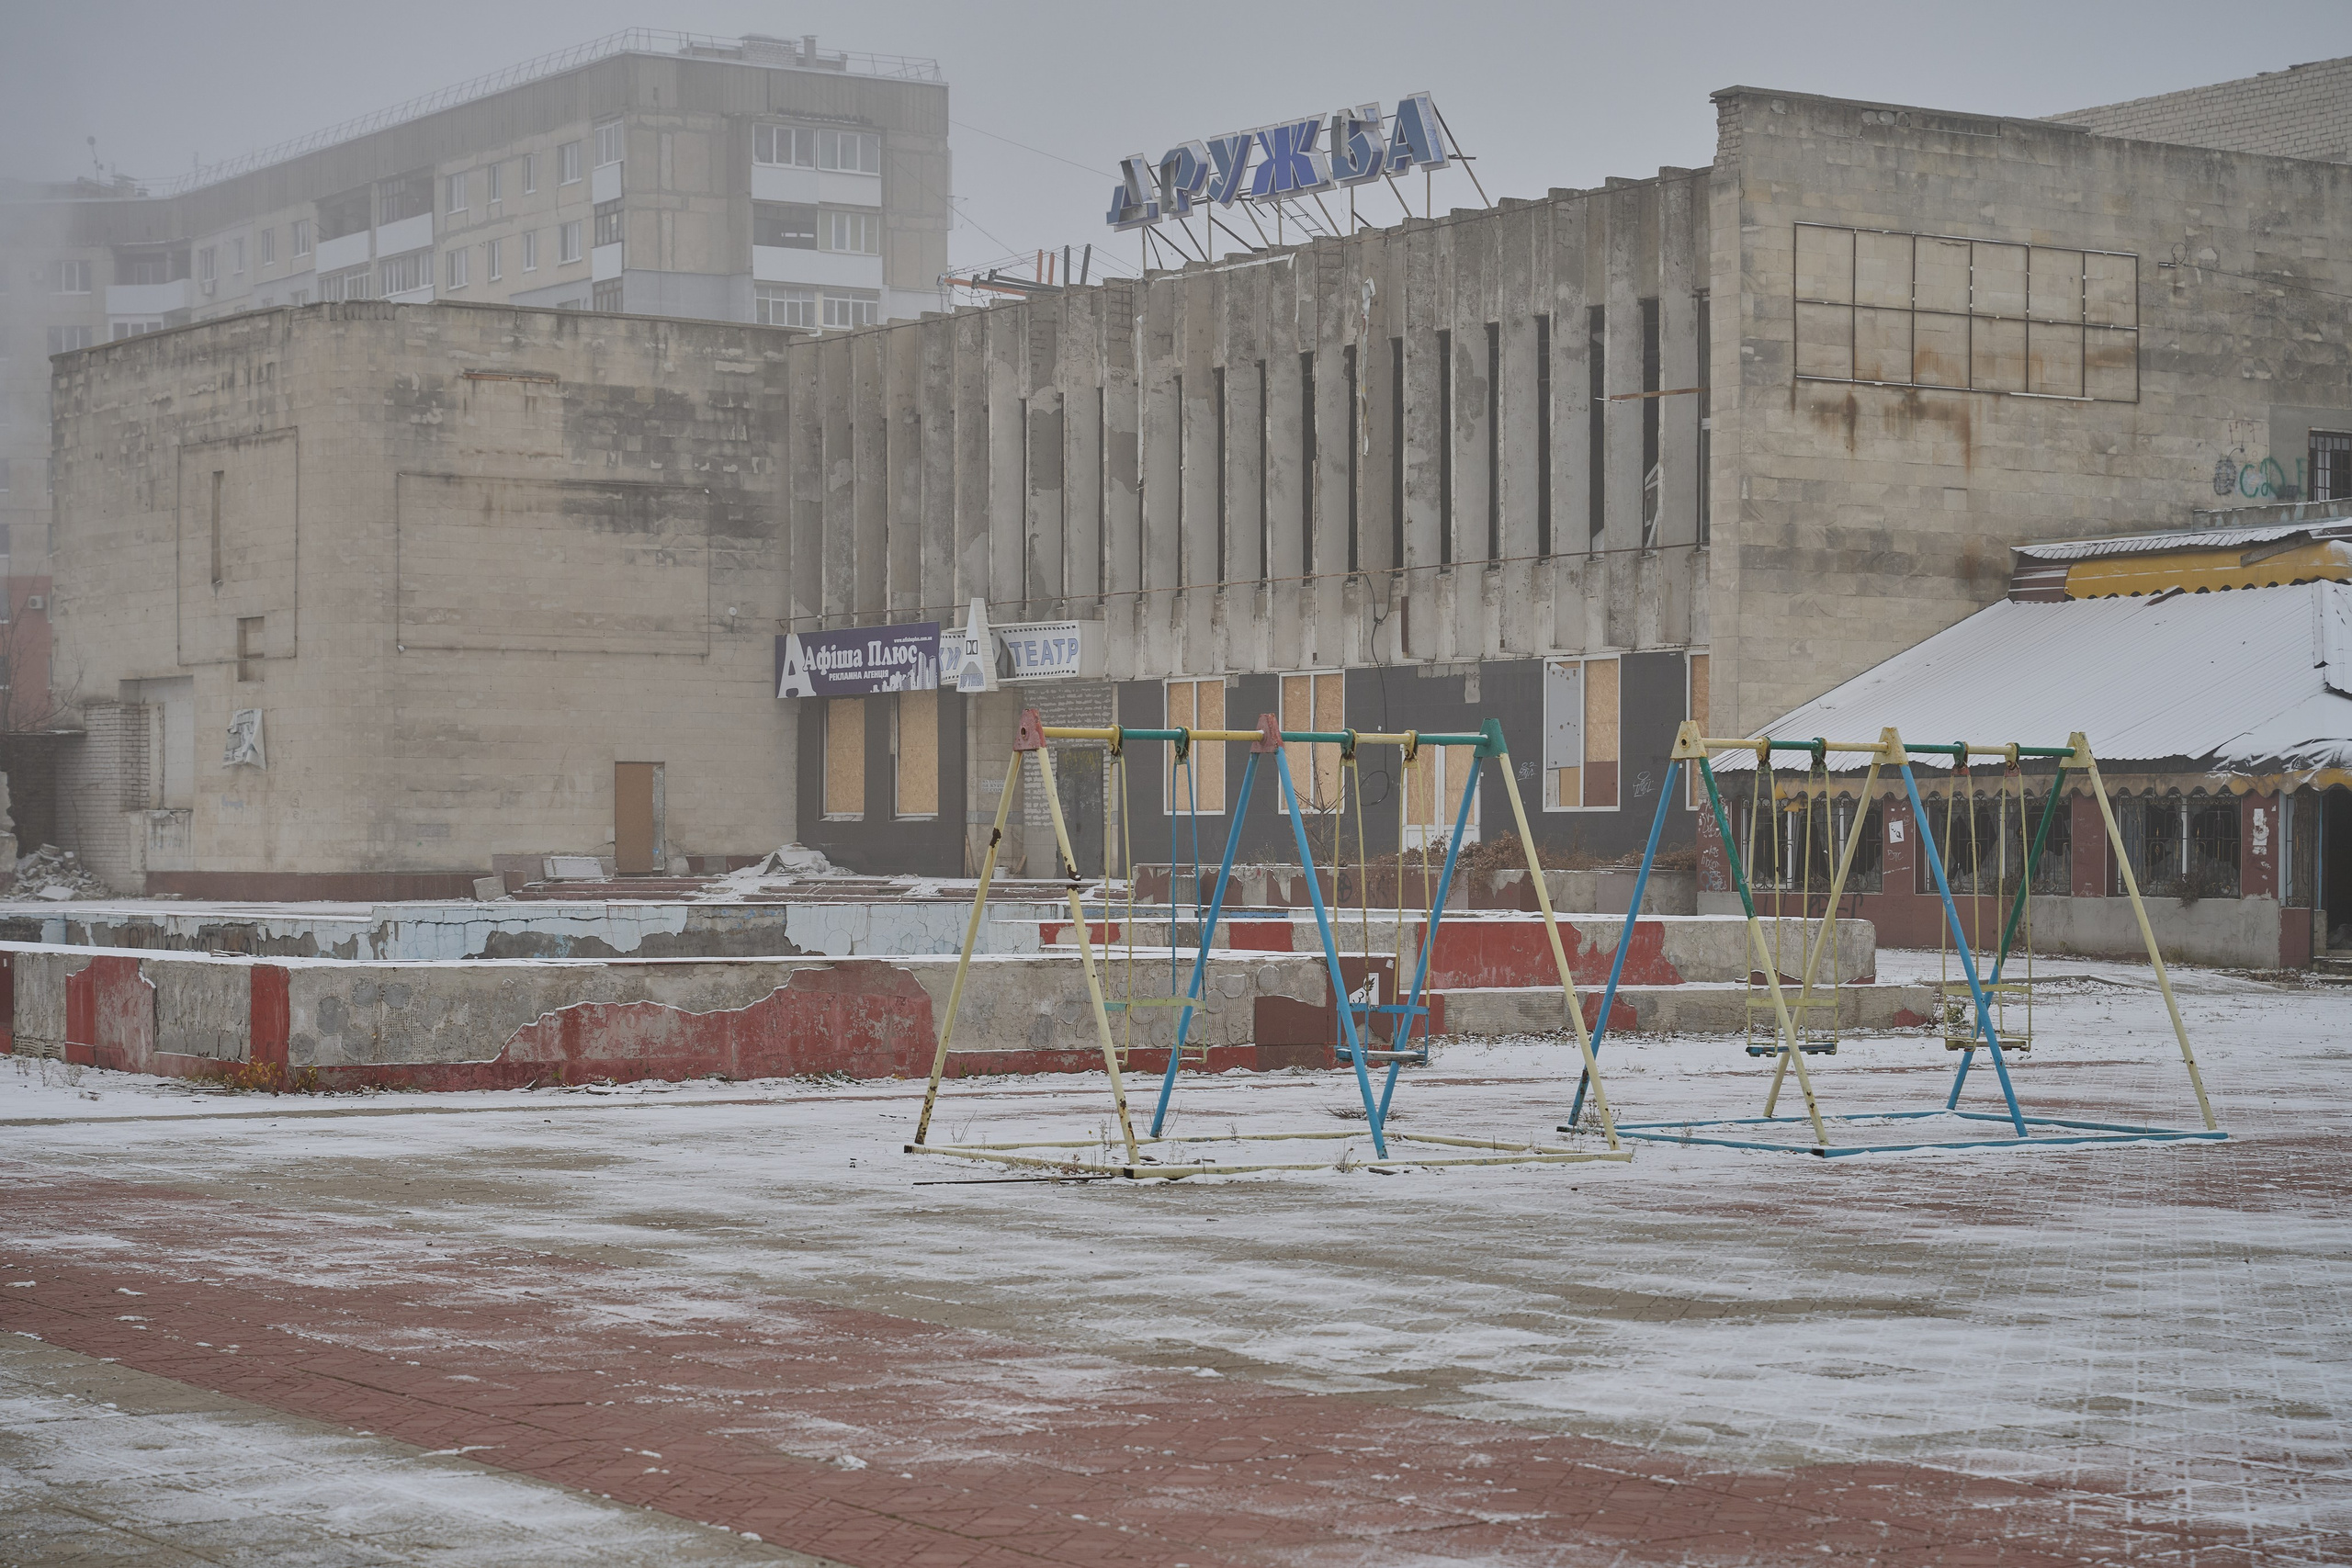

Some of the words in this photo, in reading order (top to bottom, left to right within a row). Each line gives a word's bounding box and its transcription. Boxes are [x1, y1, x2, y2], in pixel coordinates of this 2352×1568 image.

[1106, 91, 1450, 232] ДРУЖБА
[802, 644, 863, 675] Афіша
[867, 640, 917, 666] Плюс
[829, 671, 862, 681] РЕКЛАМНА
[864, 670, 889, 679] АГЕНЦІЯ
[959, 673, 984, 688] ДРУЖБА
